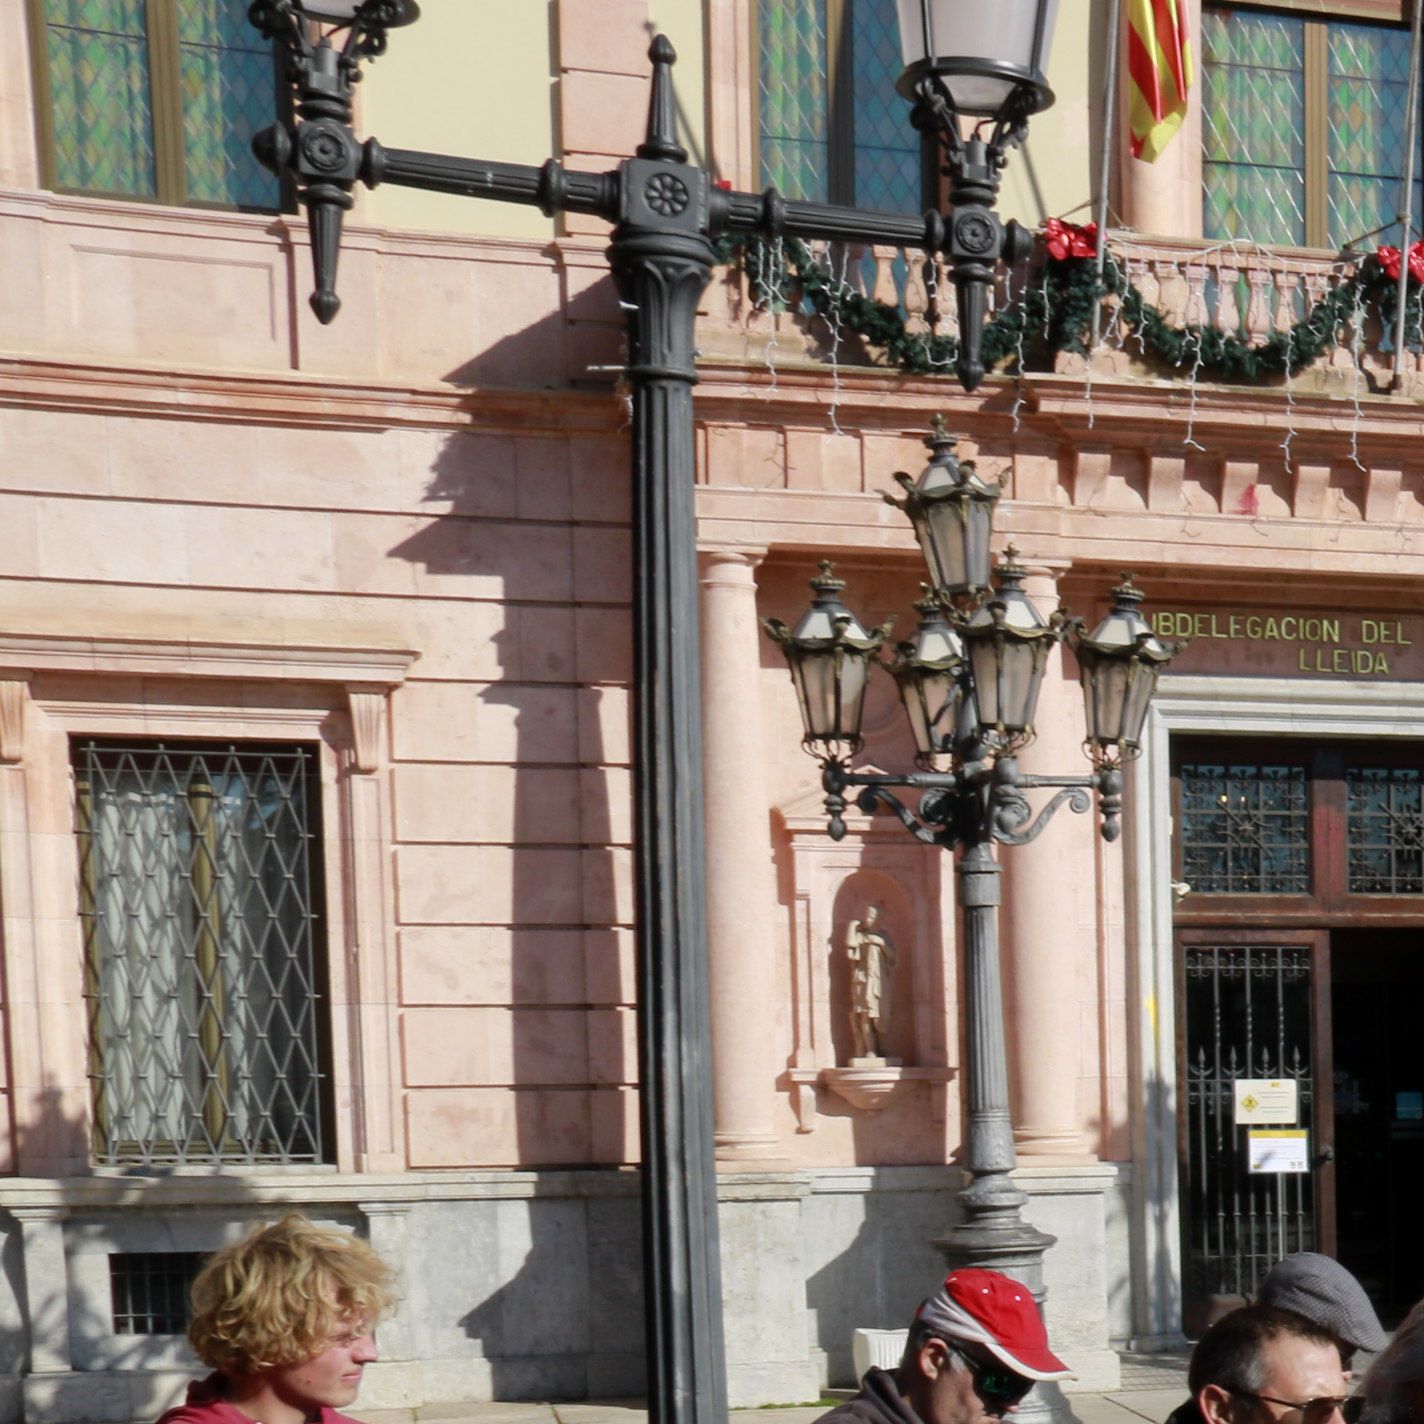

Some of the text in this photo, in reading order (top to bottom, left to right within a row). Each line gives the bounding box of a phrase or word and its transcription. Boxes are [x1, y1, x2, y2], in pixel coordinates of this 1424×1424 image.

[1140, 611, 1340, 643] UBDELEGACION
[1361, 619, 1413, 645] DEL
[1299, 648, 1389, 675] LLEIDA
